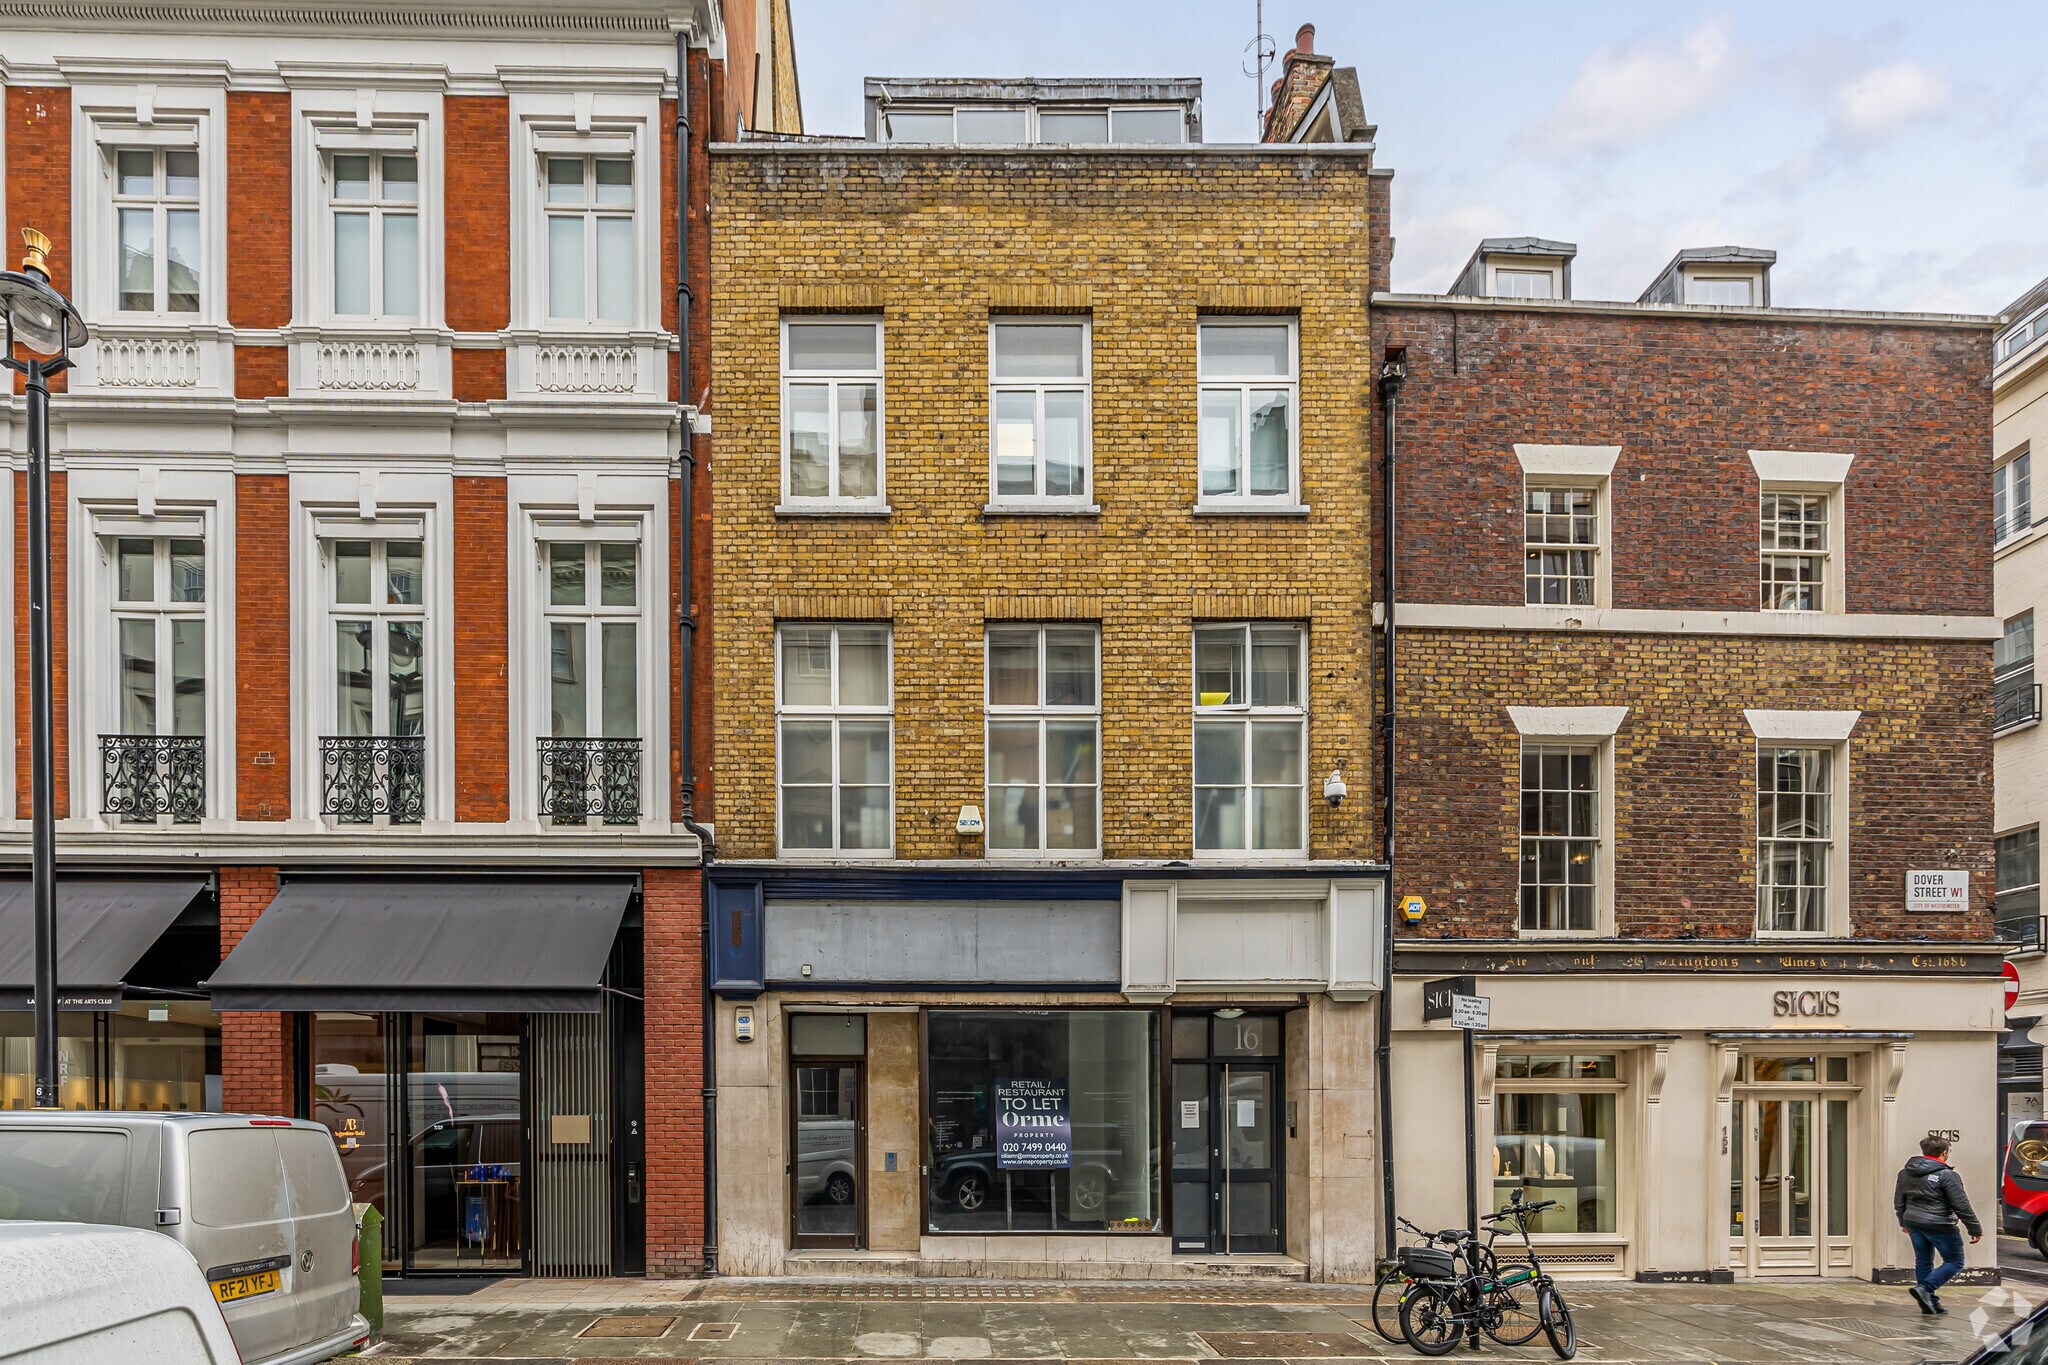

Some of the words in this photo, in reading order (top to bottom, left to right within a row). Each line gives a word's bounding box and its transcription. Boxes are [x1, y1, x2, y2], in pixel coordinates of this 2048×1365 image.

[1914, 874, 1944, 885] DOVER
[1914, 887, 1947, 898] STREET
[1950, 887, 1963, 898] W1
[1773, 990, 1840, 1017] SICIS
[1234, 1022, 1259, 1050] 16
[1011, 1081, 1046, 1089] RETAIL
[36, 1087, 43, 1096] 6
[998, 1089, 1066, 1097] RESTAURANT
[1001, 1098, 1027, 1110] TO
[1032, 1098, 1061, 1110] LET
[1002, 1112, 1064, 1127] Orme
[1002, 1143, 1019, 1152] 020
[1021, 1143, 1043, 1152] 7499
[1045, 1143, 1067, 1152] 0440
[231, 1261, 276, 1274] TRANSPORTER
[219, 1278, 250, 1298] RF21
[250, 1273, 275, 1291] YFJ
